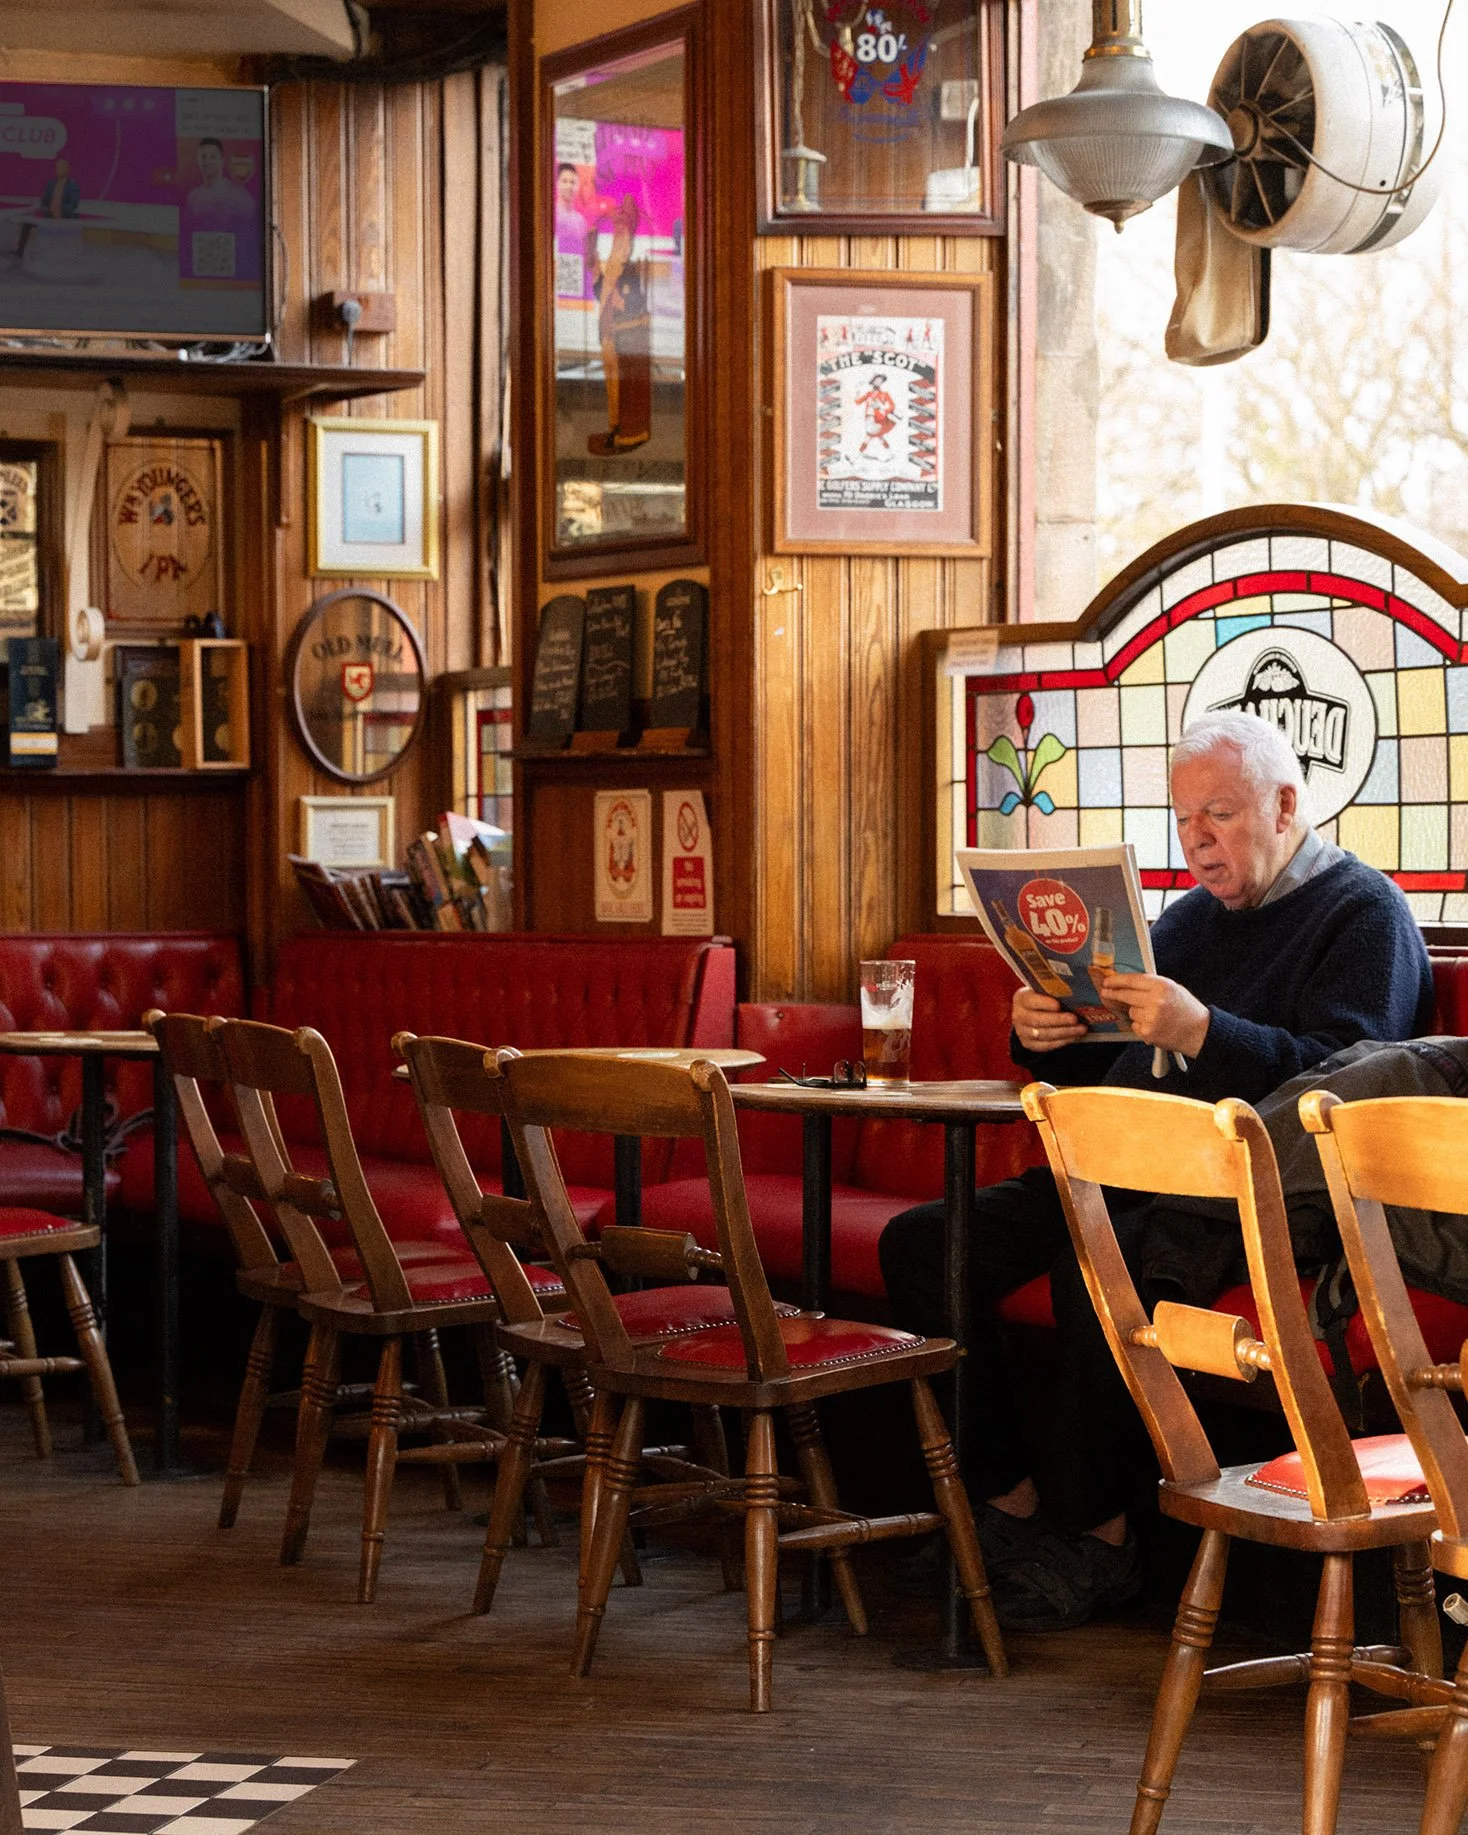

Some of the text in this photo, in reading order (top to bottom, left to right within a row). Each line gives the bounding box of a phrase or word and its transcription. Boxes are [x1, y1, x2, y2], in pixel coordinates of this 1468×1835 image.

[2, 125, 56, 143] CLUB
[830, 351, 862, 371] THE
[1025, 892, 1066, 908] Save
[1029, 908, 1086, 937] 40%
